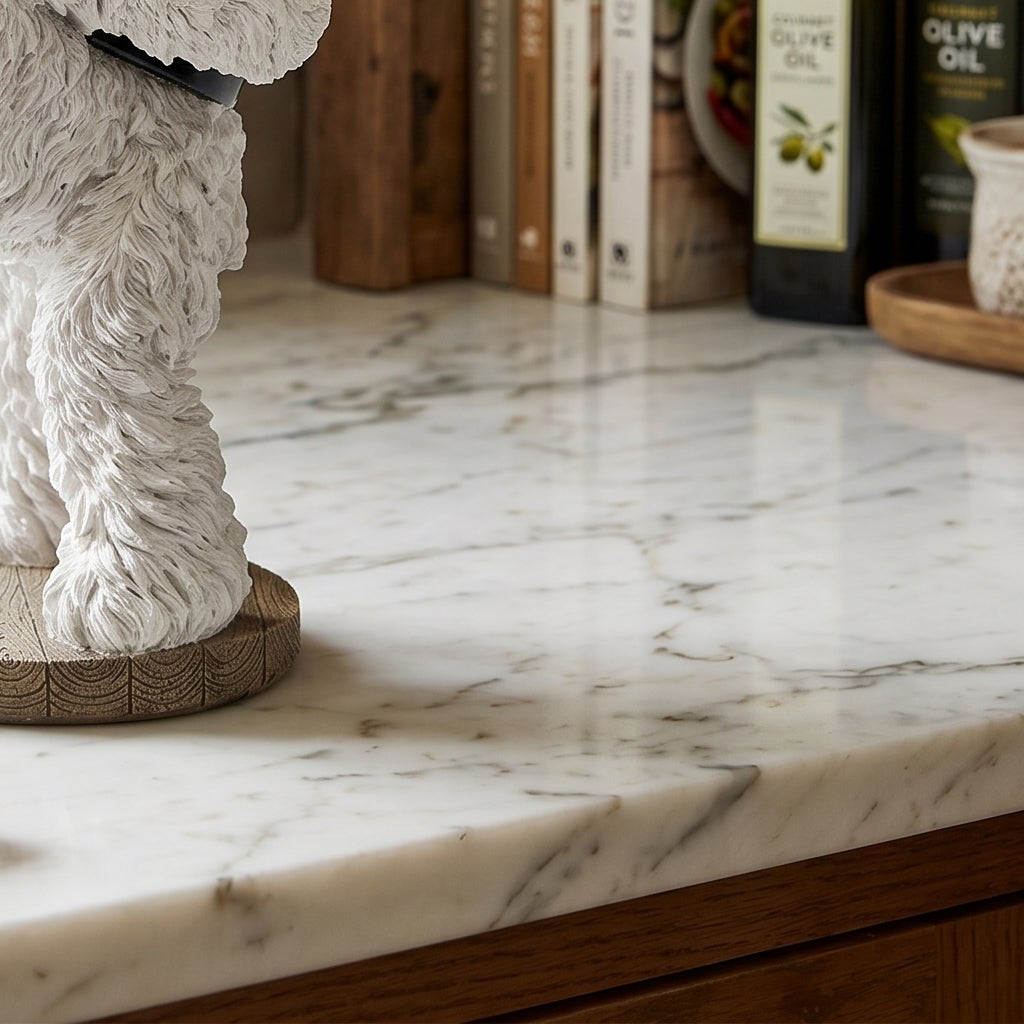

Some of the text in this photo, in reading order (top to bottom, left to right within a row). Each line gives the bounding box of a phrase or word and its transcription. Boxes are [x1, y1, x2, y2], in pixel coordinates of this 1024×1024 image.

[770, 28, 835, 51] OLIVE
[922, 18, 1005, 49] OLIVE
[784, 49, 820, 70] OIL
[937, 45, 986, 74] OIL
